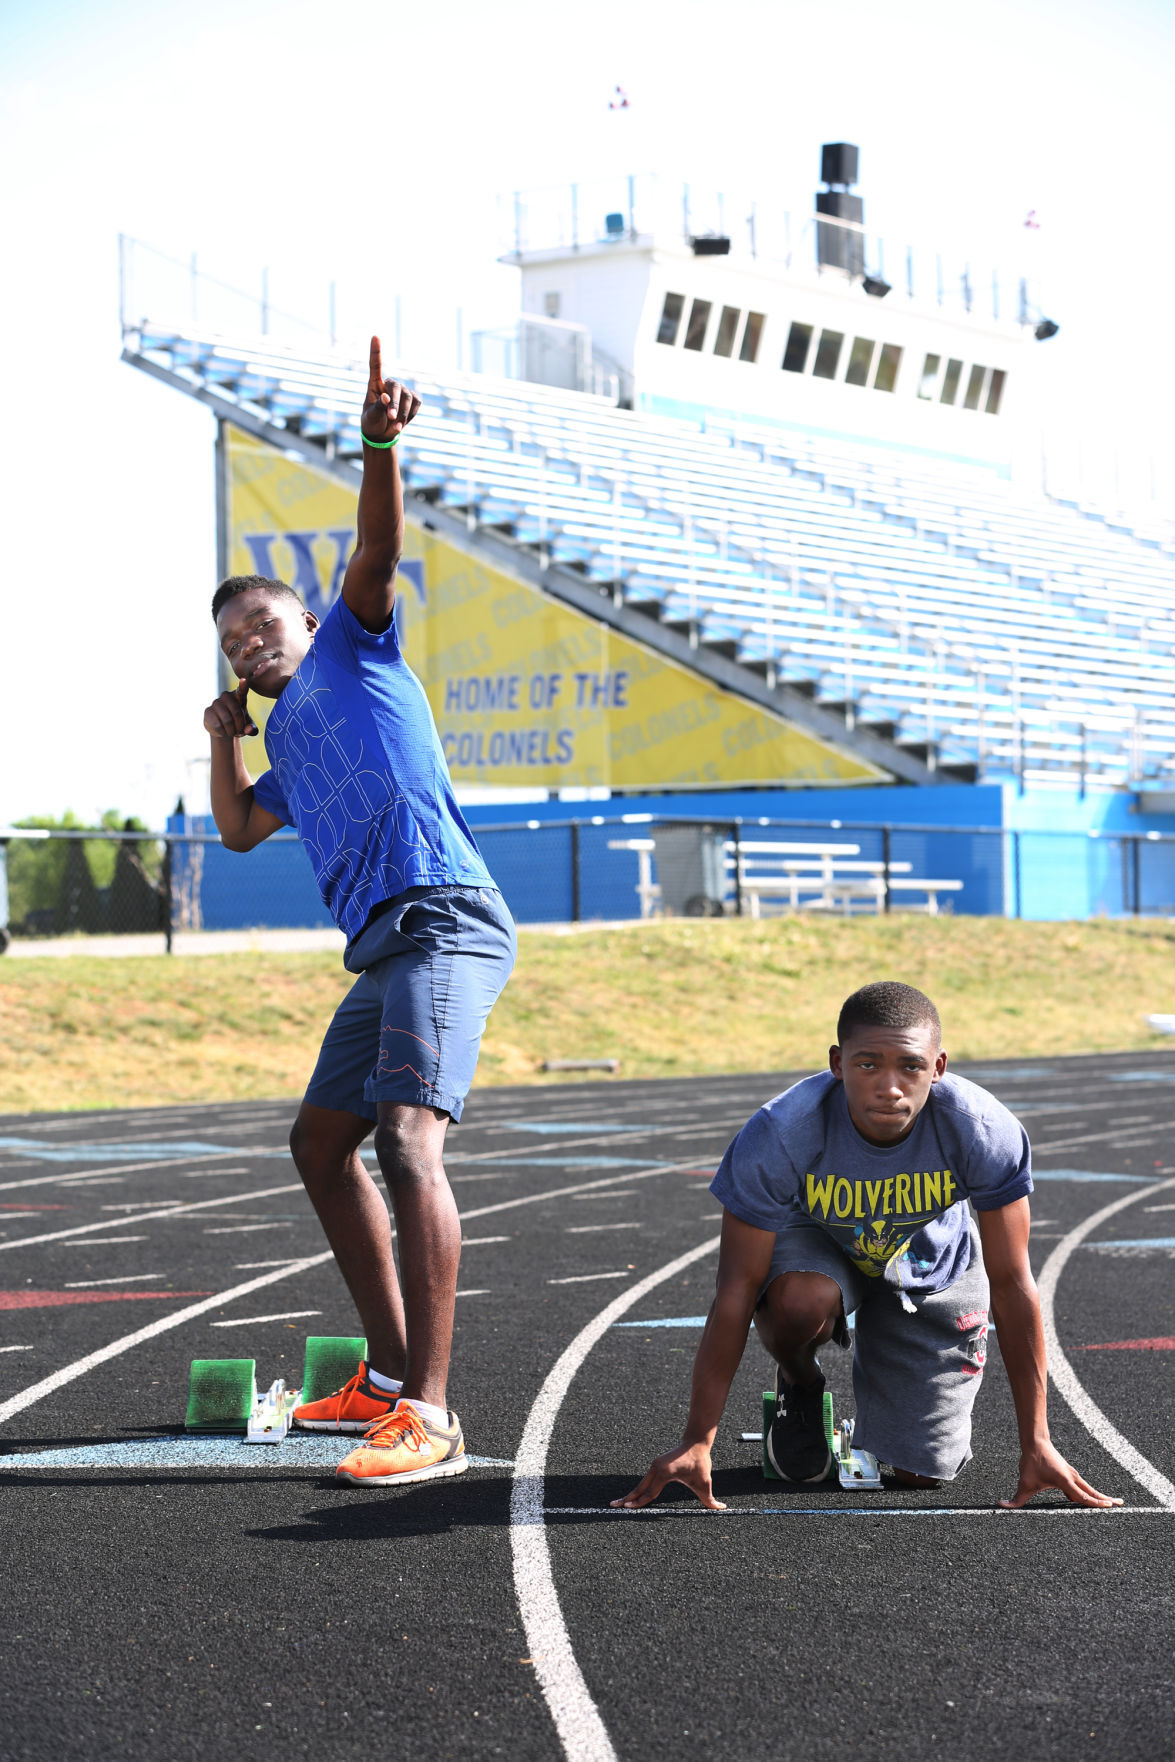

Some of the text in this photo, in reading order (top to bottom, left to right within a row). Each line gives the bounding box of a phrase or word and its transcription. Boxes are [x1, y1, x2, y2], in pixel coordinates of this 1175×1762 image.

[445, 671, 630, 713] HOME OF THE
[443, 729, 575, 767] COLONELS
[806, 1169, 957, 1221] WOLVERINE
